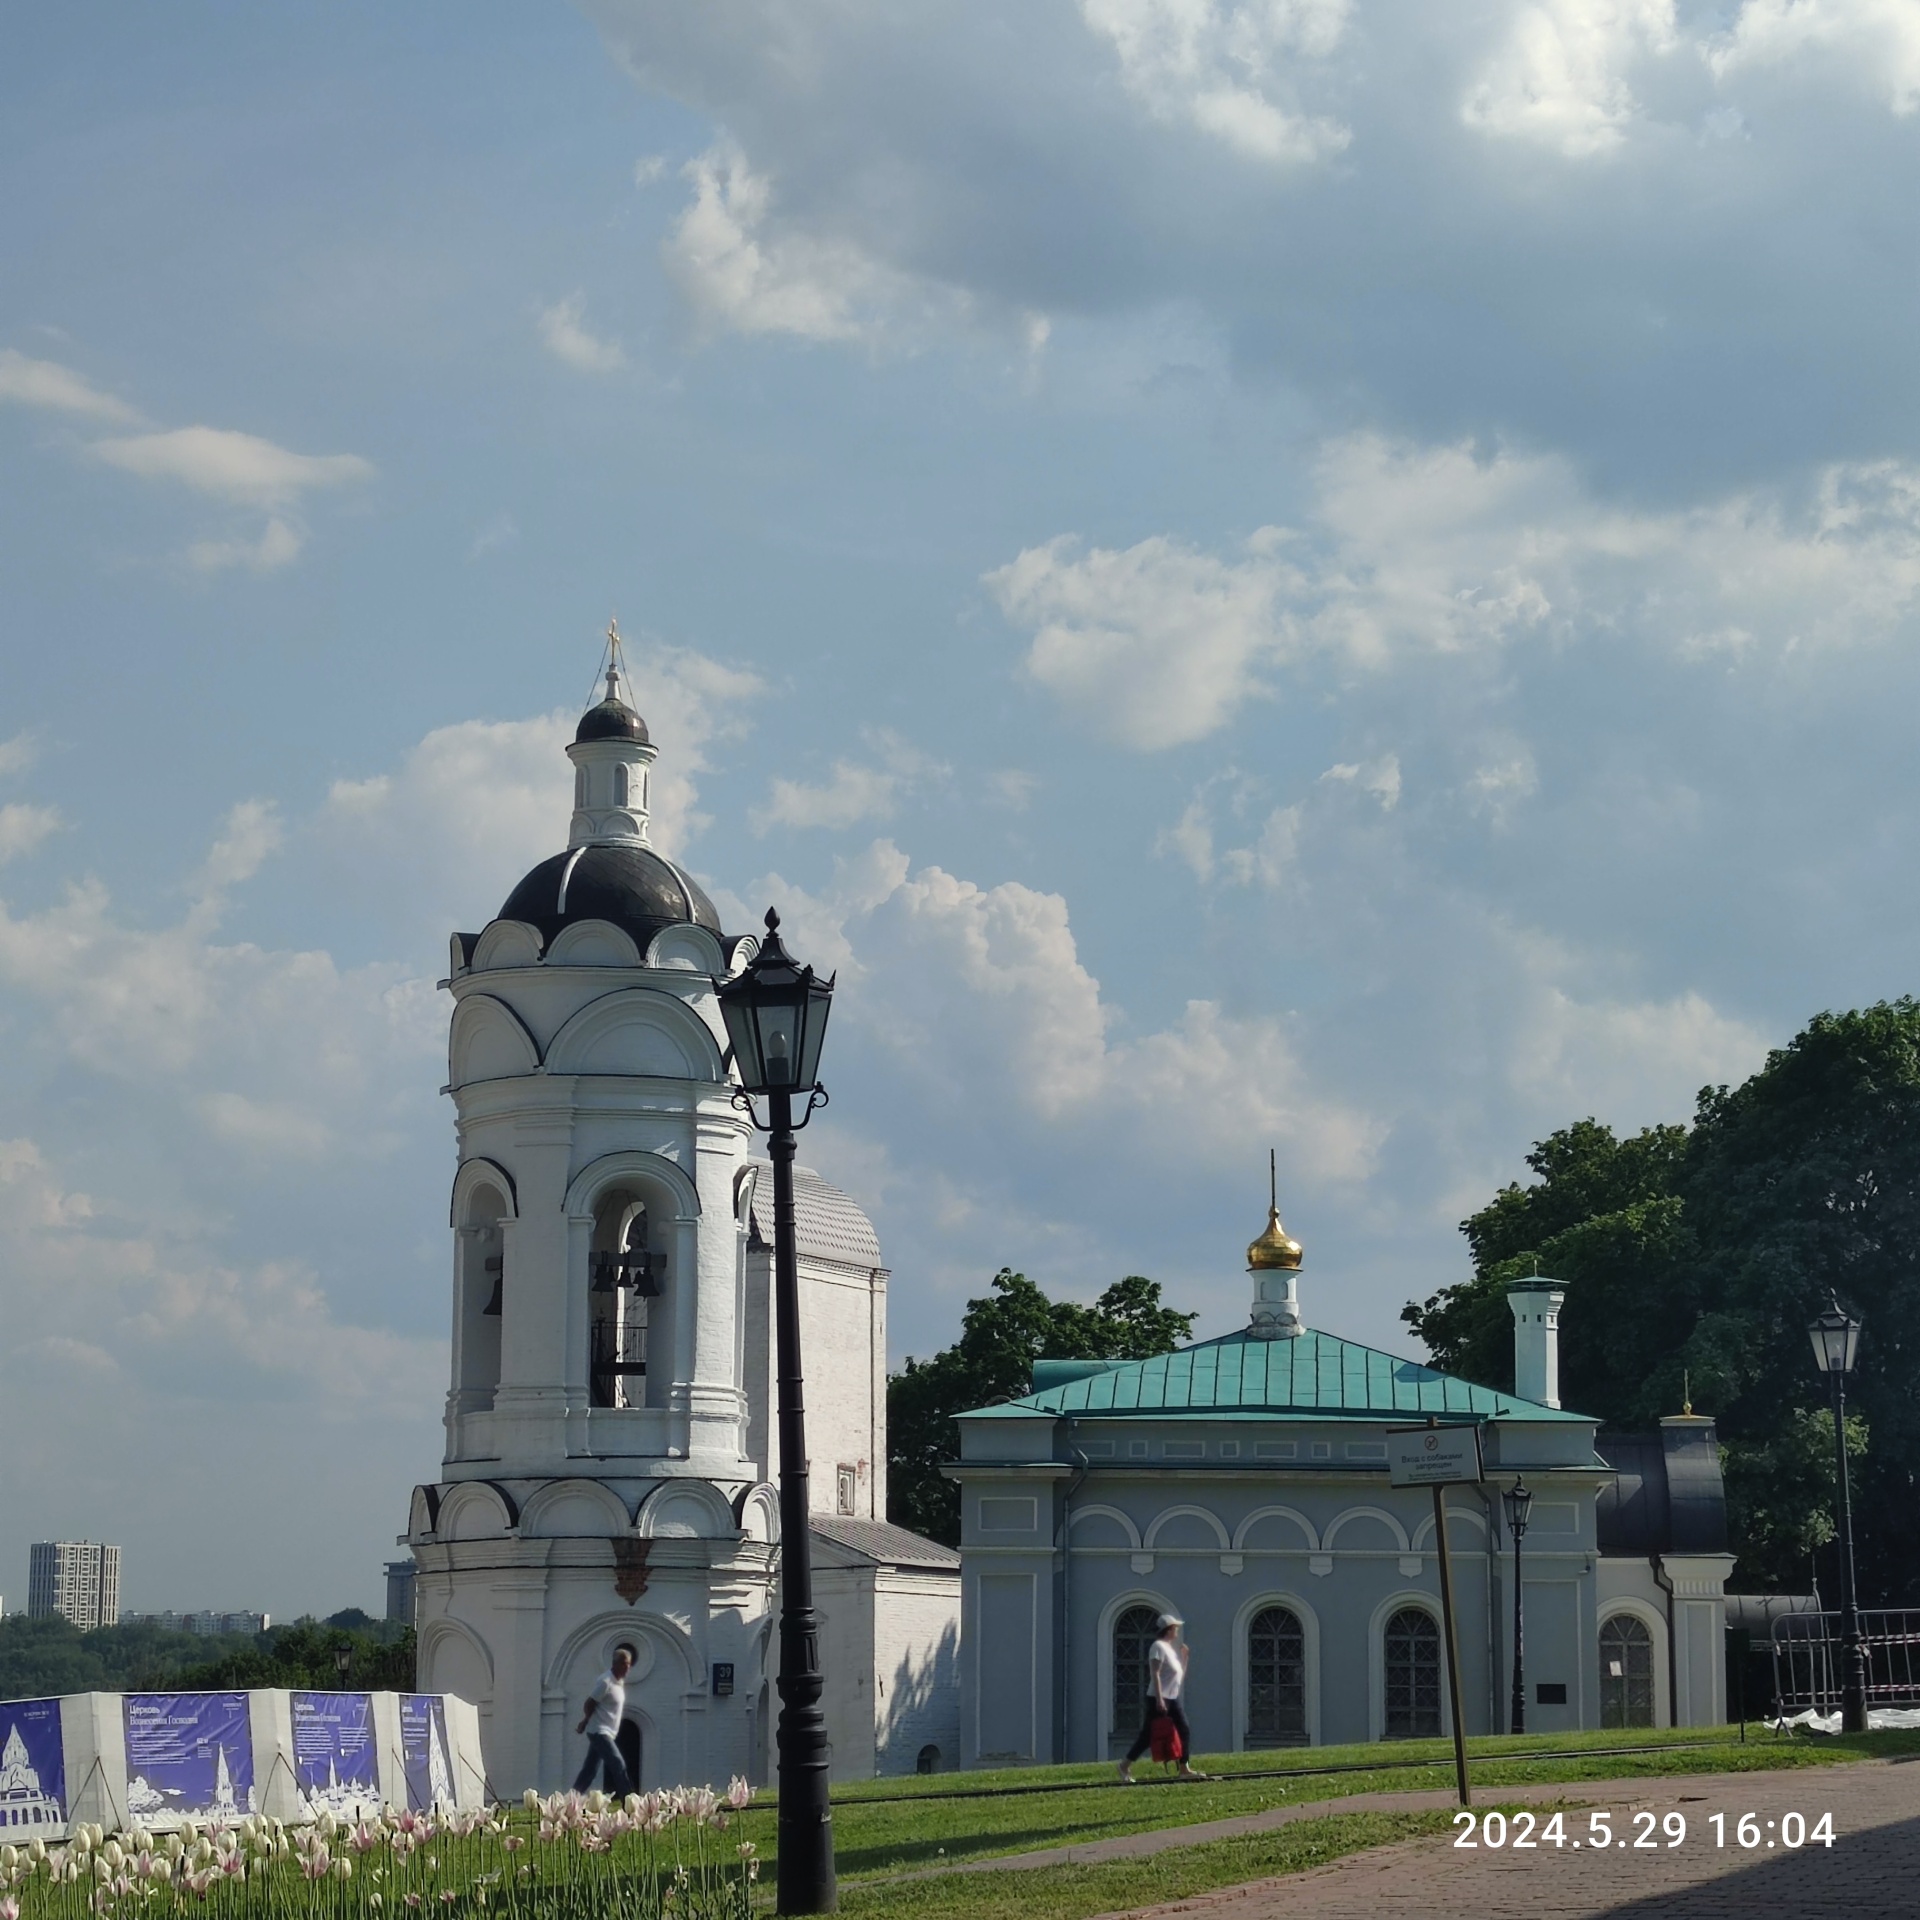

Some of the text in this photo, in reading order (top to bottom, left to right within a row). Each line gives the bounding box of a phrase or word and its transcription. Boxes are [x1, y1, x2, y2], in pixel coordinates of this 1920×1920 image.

[1401, 1455, 1420, 1463] Вход
[1427, 1453, 1463, 1461] собаками
[719, 1666, 732, 1677] 39
[129, 1705, 160, 1716] Церковь
